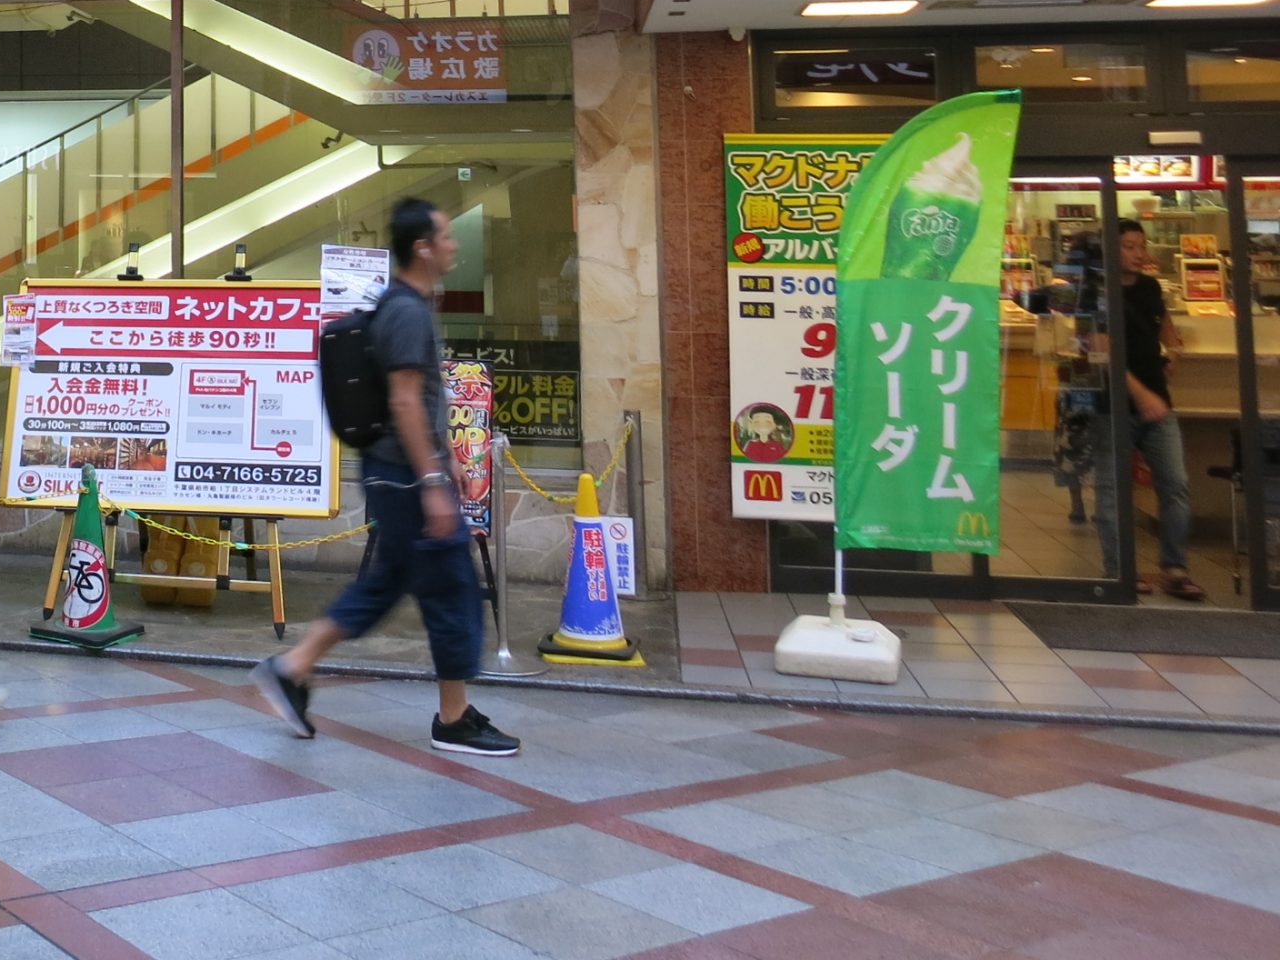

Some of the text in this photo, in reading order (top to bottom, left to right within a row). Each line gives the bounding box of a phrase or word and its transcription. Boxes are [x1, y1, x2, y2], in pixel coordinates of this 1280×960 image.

[762, 238, 839, 260] アルバ
[38, 298, 163, 315] 上質なくつろぎ空間
[89, 329, 276, 350] ここから徒歩90秒!!
[58, 362, 141, 374] 新規ご入会特典
[276, 370, 314, 384] MAP
[47, 377, 149, 396] 入会金無料!
[35, 395, 120, 417] 1,000円分の
[128, 397, 164, 407] クーポン
[871, 321, 919, 473] ソーダ
[926, 295, 975, 502] クリーム
[192, 465, 318, 483] 04-7166-5725
[44, 479, 74, 493] SILK
